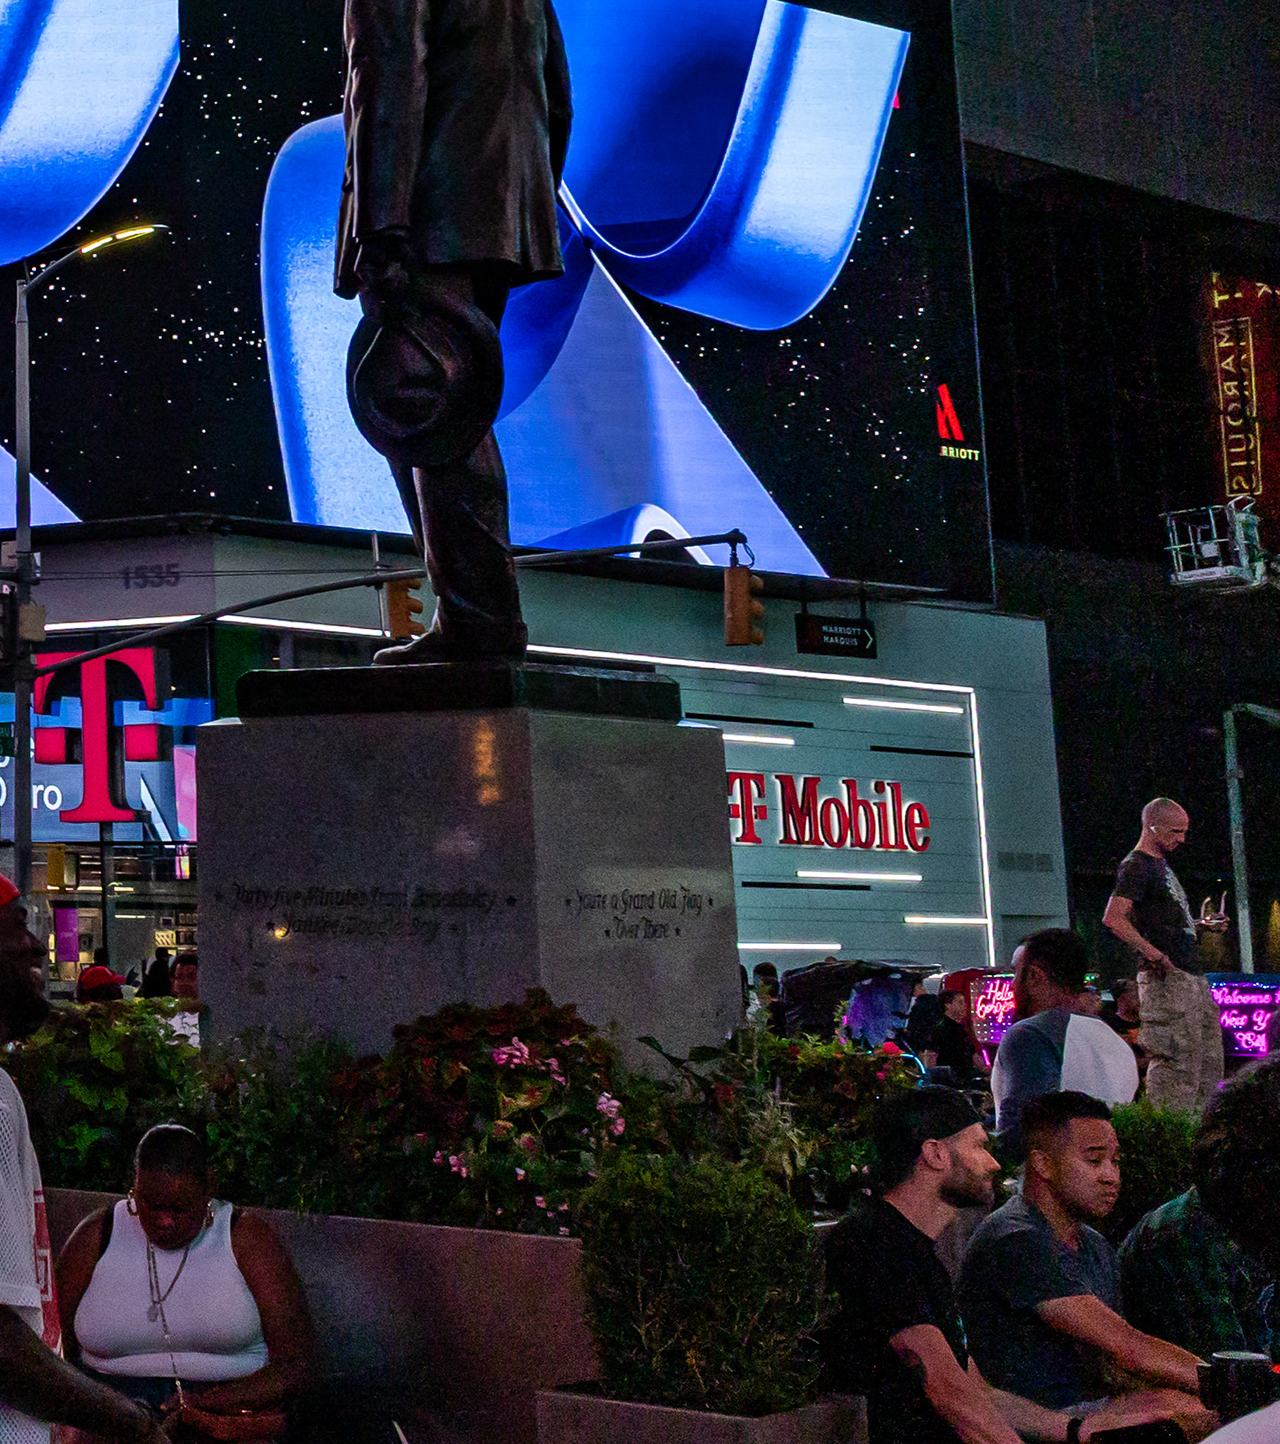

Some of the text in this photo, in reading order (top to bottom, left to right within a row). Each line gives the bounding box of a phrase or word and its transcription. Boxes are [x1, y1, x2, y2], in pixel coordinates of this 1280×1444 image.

[822, 625, 861, 636] MARRIOTT
[823, 635, 858, 646] MARQUIS
[32, 785, 62, 810] ro
[775, 774, 931, 852] Mobile
[1210, 987, 1272, 1005] Welcome
